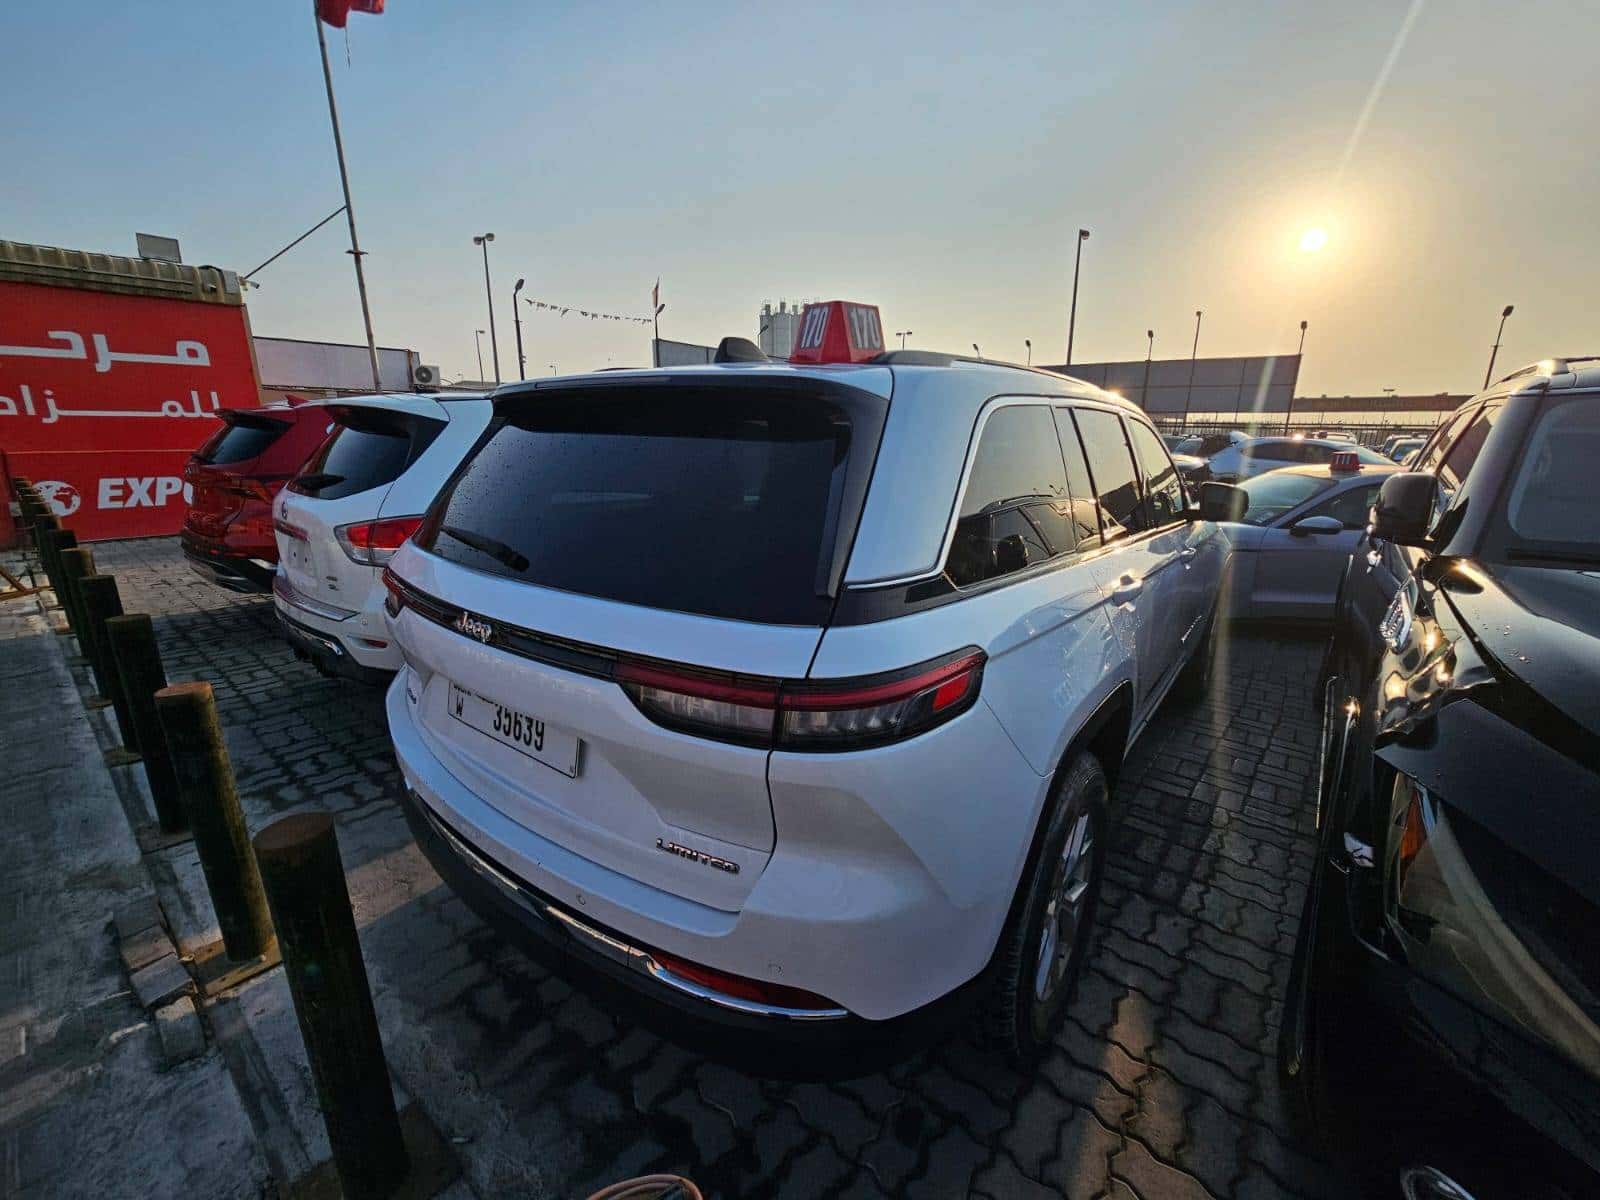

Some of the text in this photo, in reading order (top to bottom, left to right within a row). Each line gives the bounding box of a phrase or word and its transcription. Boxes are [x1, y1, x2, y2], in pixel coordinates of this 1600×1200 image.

[800, 306, 829, 348] 170
[850, 306, 881, 349] 170
[0, 331, 211, 372] مرح
[456, 611, 492, 643] Jeep
[493, 703, 545, 751] 35639
